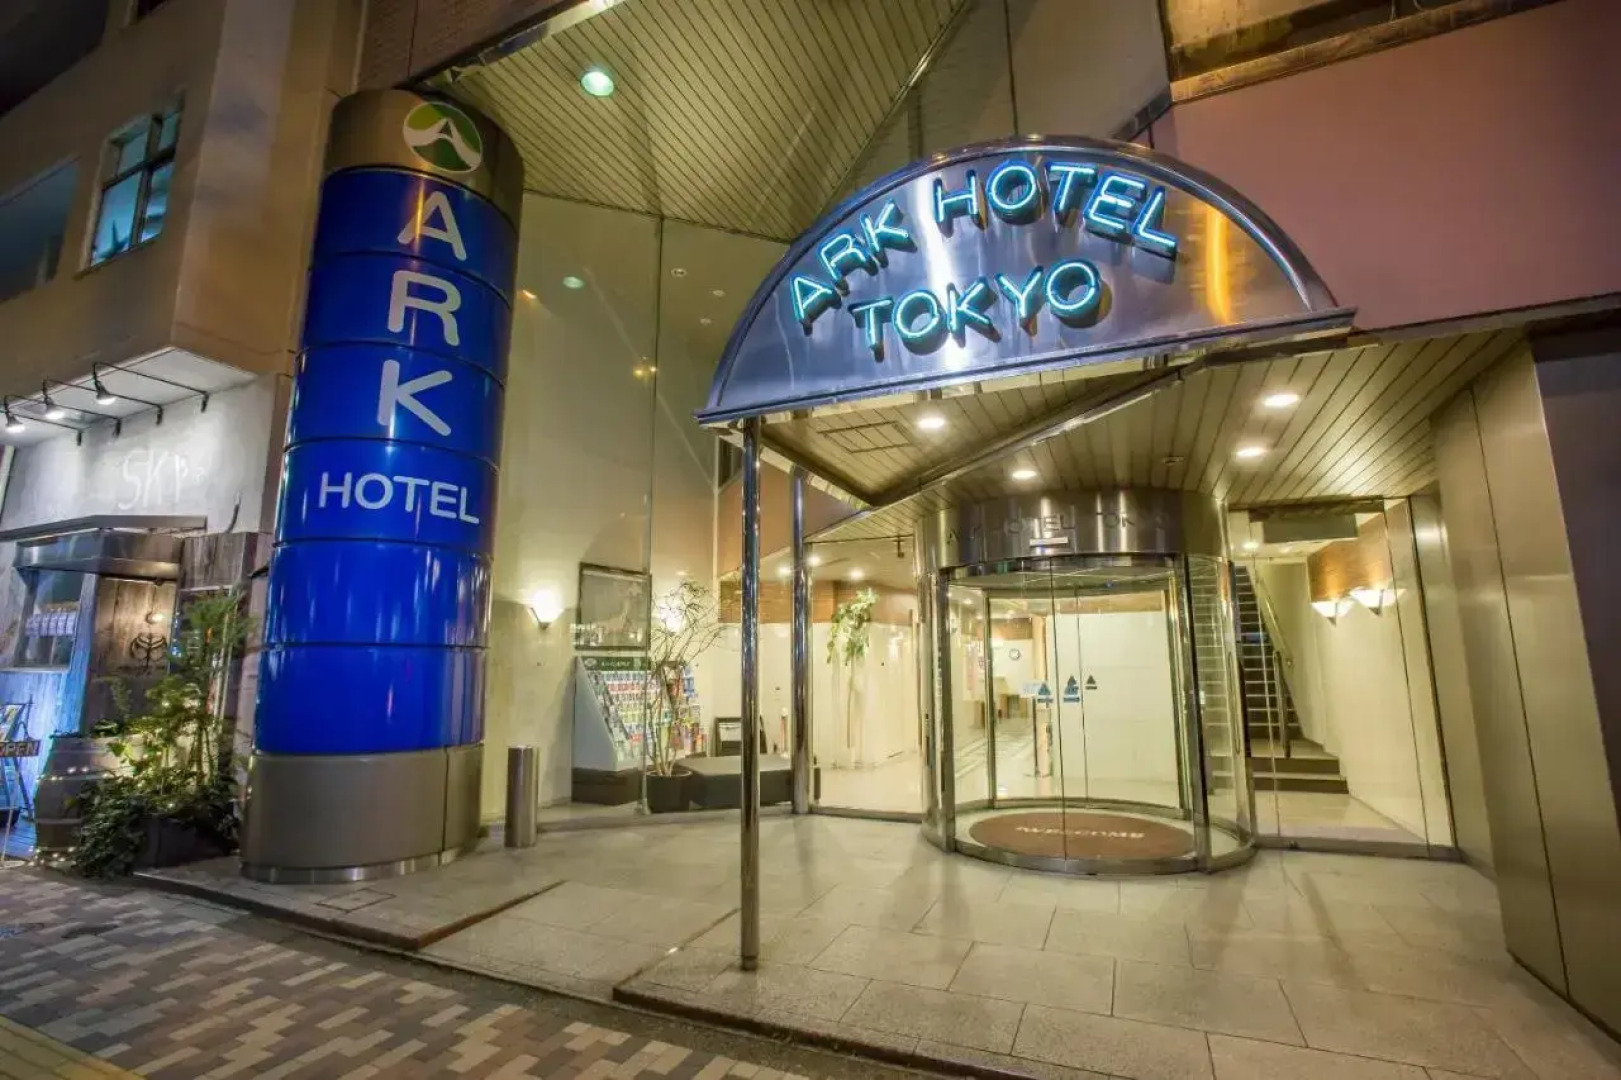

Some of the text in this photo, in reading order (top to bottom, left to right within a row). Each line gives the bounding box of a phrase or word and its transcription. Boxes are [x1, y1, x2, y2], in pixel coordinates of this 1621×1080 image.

[789, 158, 1179, 323] ARK HOTEL
[376, 190, 467, 437] ARK
[850, 257, 1102, 347] TOKYO
[318, 471, 480, 525] HOTEL
[1014, 825, 1147, 839] WELCOME
